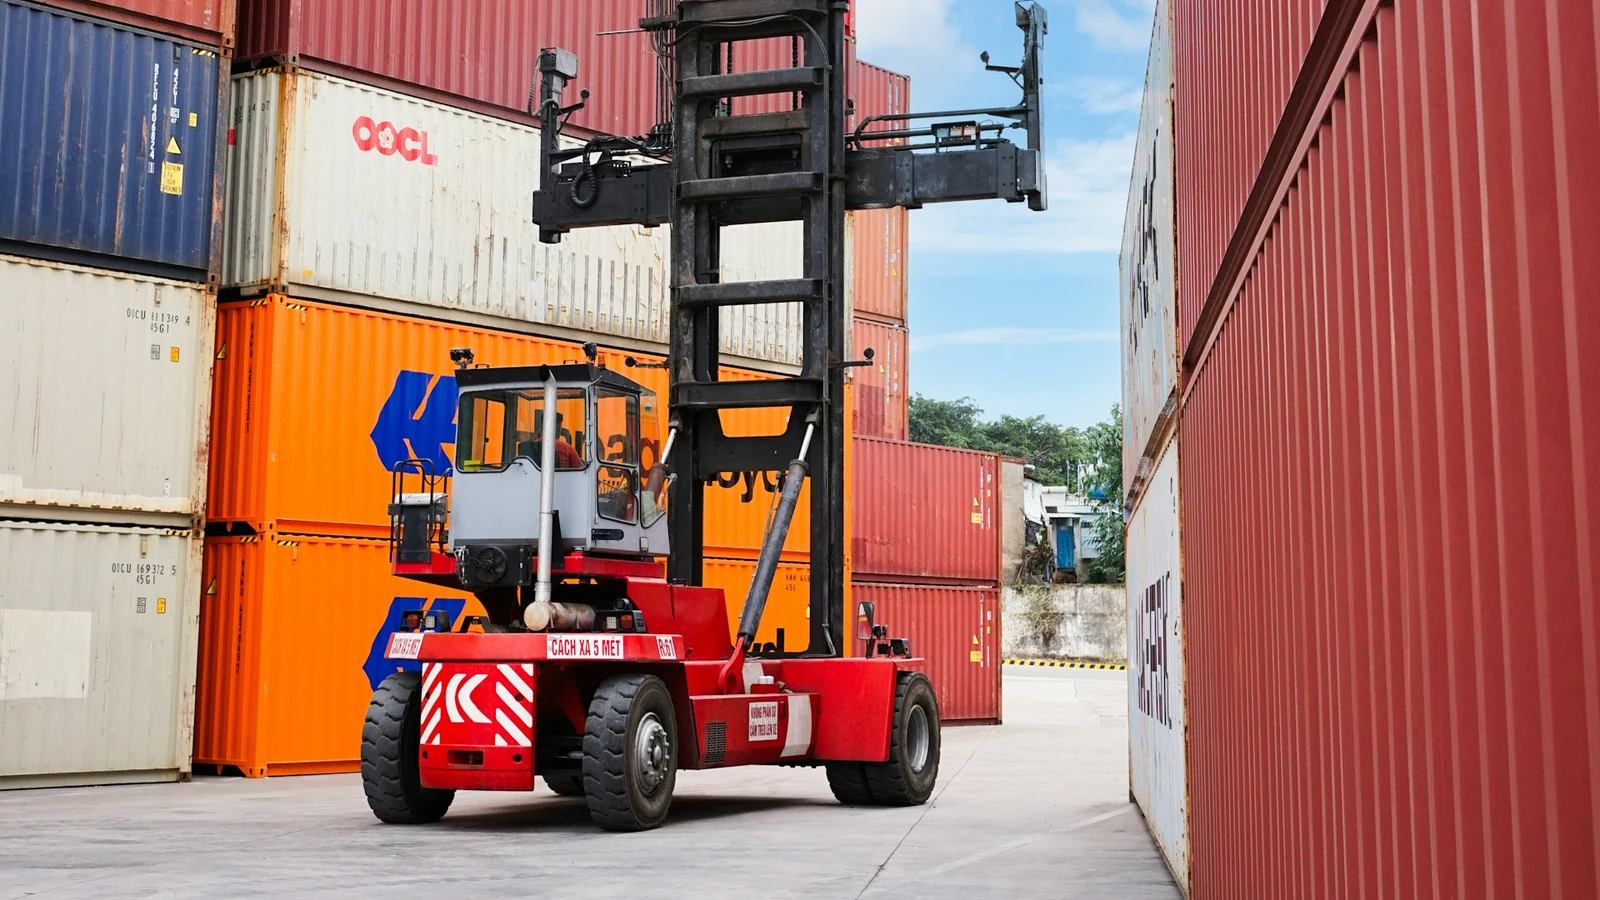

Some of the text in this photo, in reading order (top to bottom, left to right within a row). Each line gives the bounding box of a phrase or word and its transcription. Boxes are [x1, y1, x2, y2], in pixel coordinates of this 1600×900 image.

[352, 115, 439, 167] OOCL
[184, 315, 191, 327] 4
[150, 322, 170, 334] 45G1
[171, 564, 177, 576] 5
[136, 574, 156, 585] 45G1
[551, 635, 621, 657] CÁCH XA 5 MÉT
